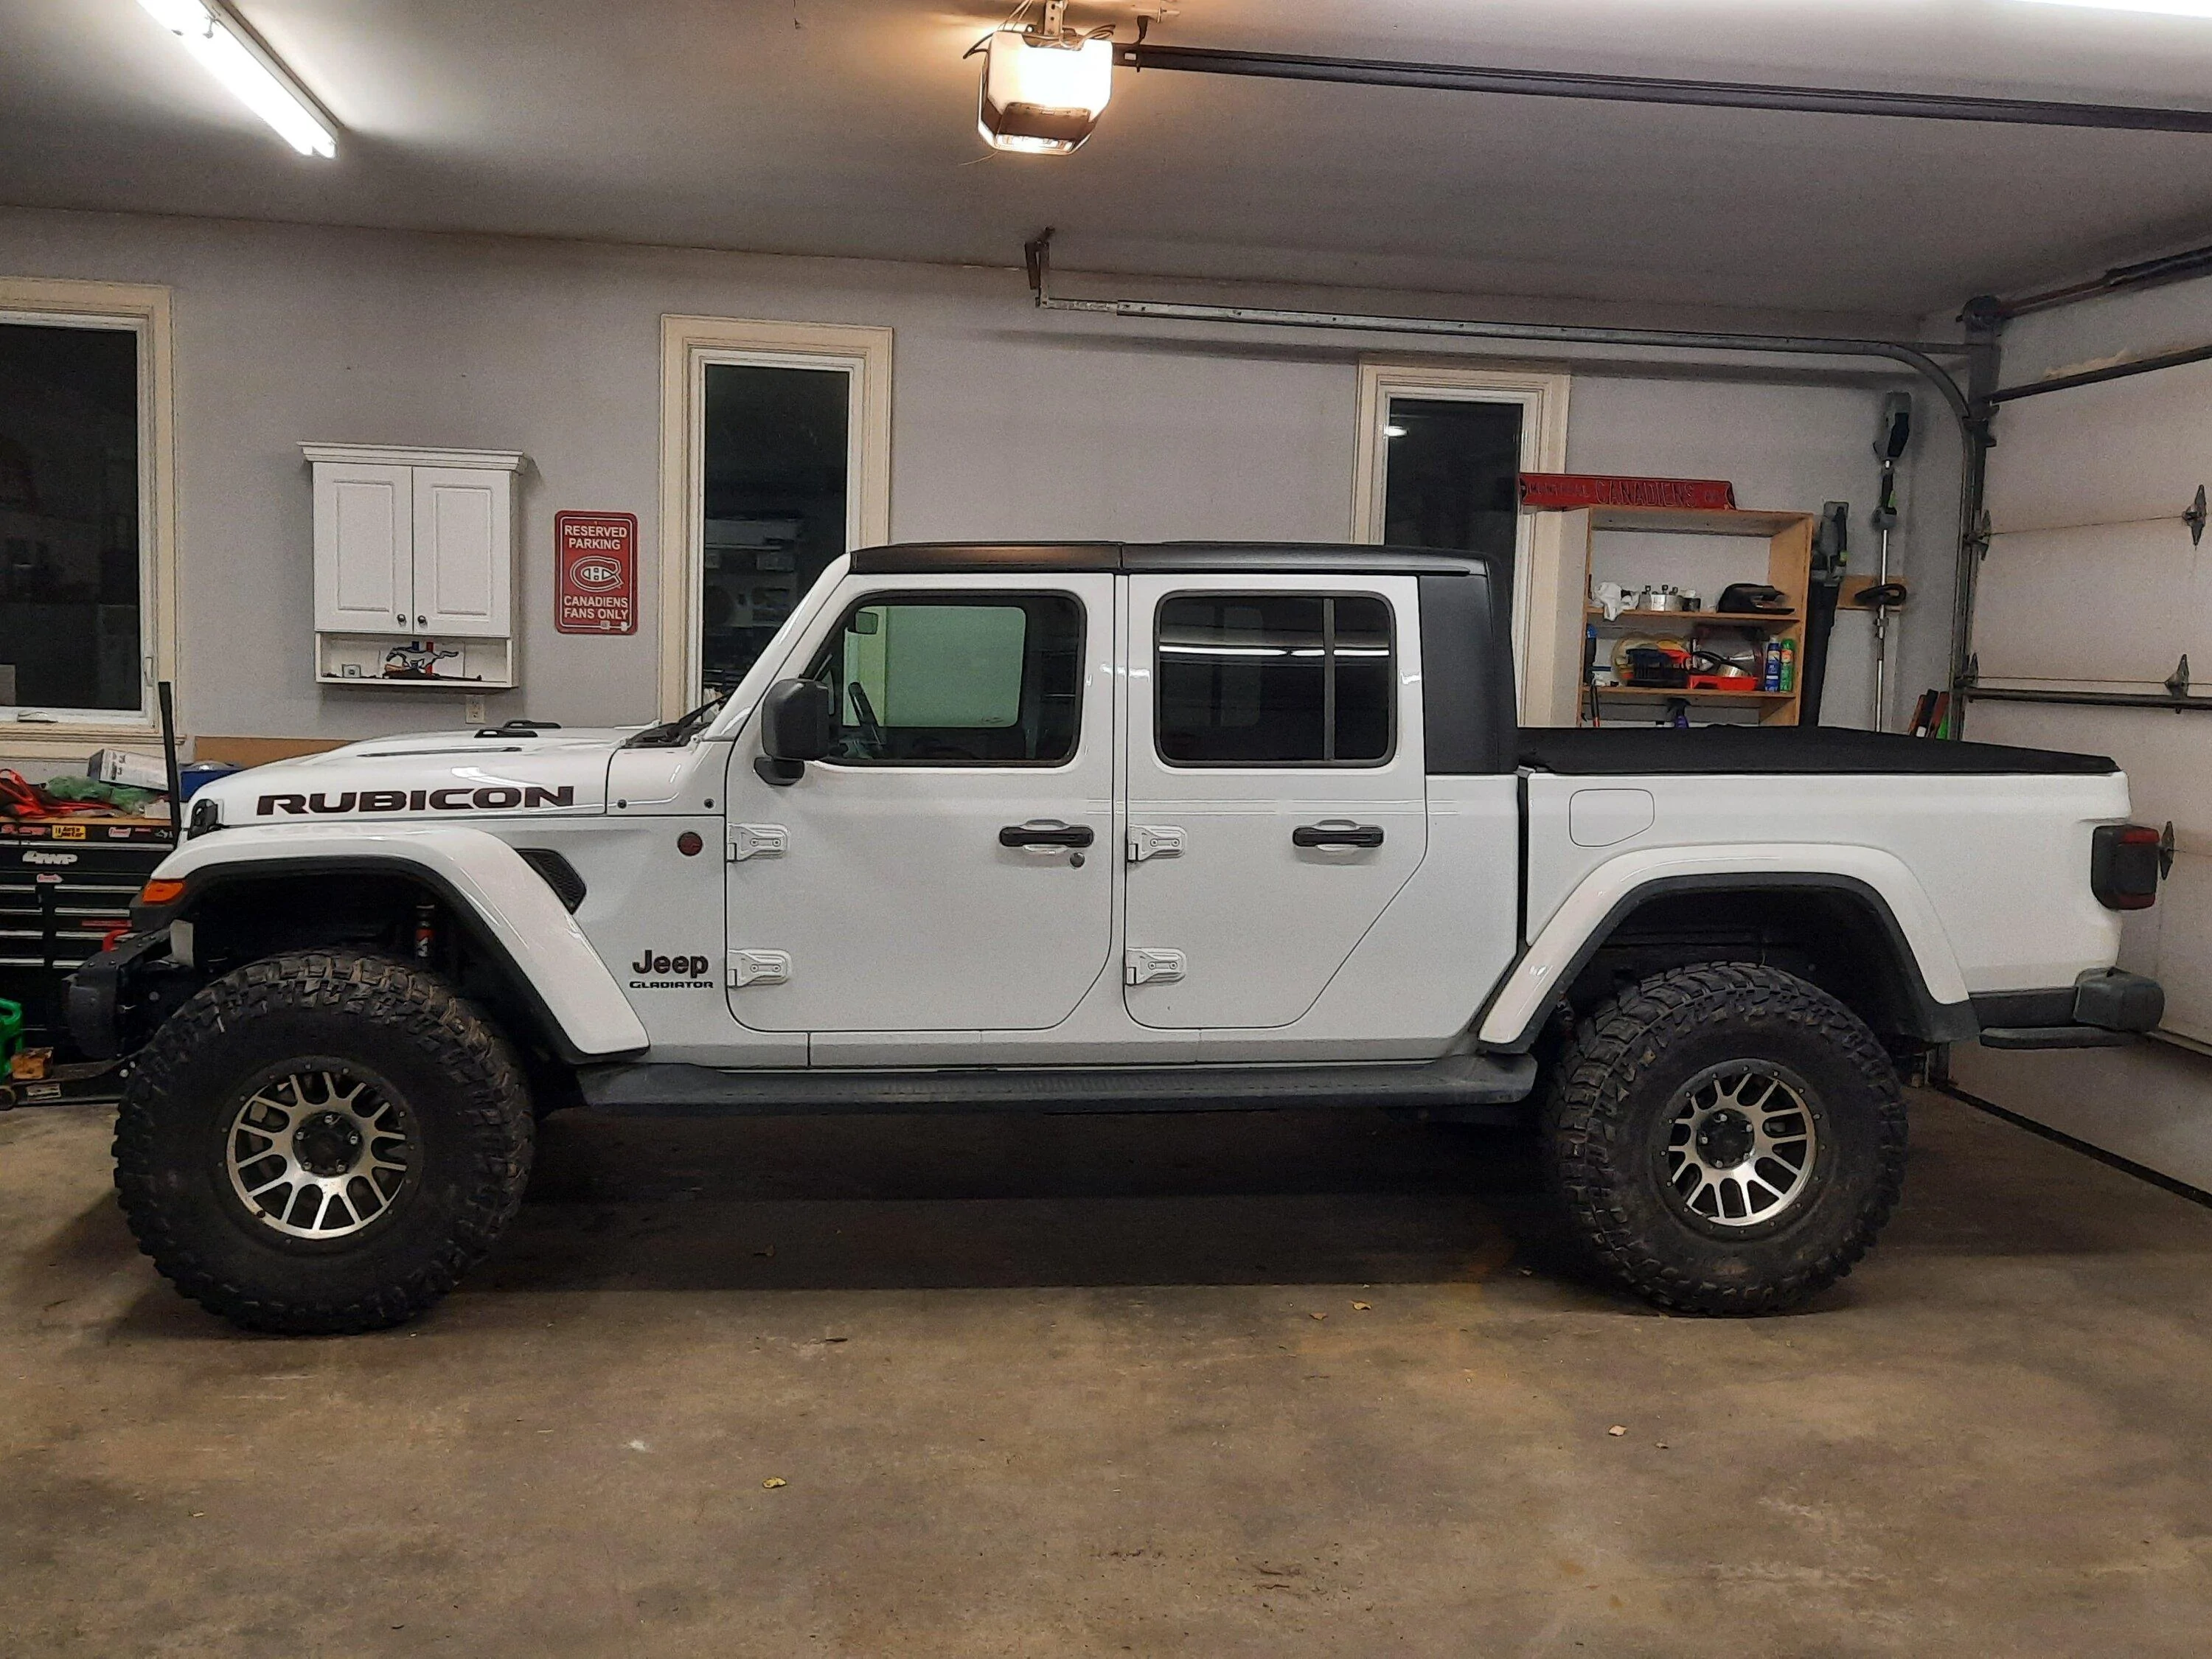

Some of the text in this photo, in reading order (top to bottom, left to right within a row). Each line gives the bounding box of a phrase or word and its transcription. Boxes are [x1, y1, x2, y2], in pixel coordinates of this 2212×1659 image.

[1596, 479, 1694, 507] CANADIENS
[564, 525, 627, 538] RESERVED
[568, 538, 621, 550] PARKING
[564, 595, 628, 608] CANADIENS
[564, 608, 628, 620] FANS ONLY
[256, 786, 574, 815] RUBICON
[632, 950, 709, 978] Jeep
[629, 981, 714, 989] GLADIATOR
